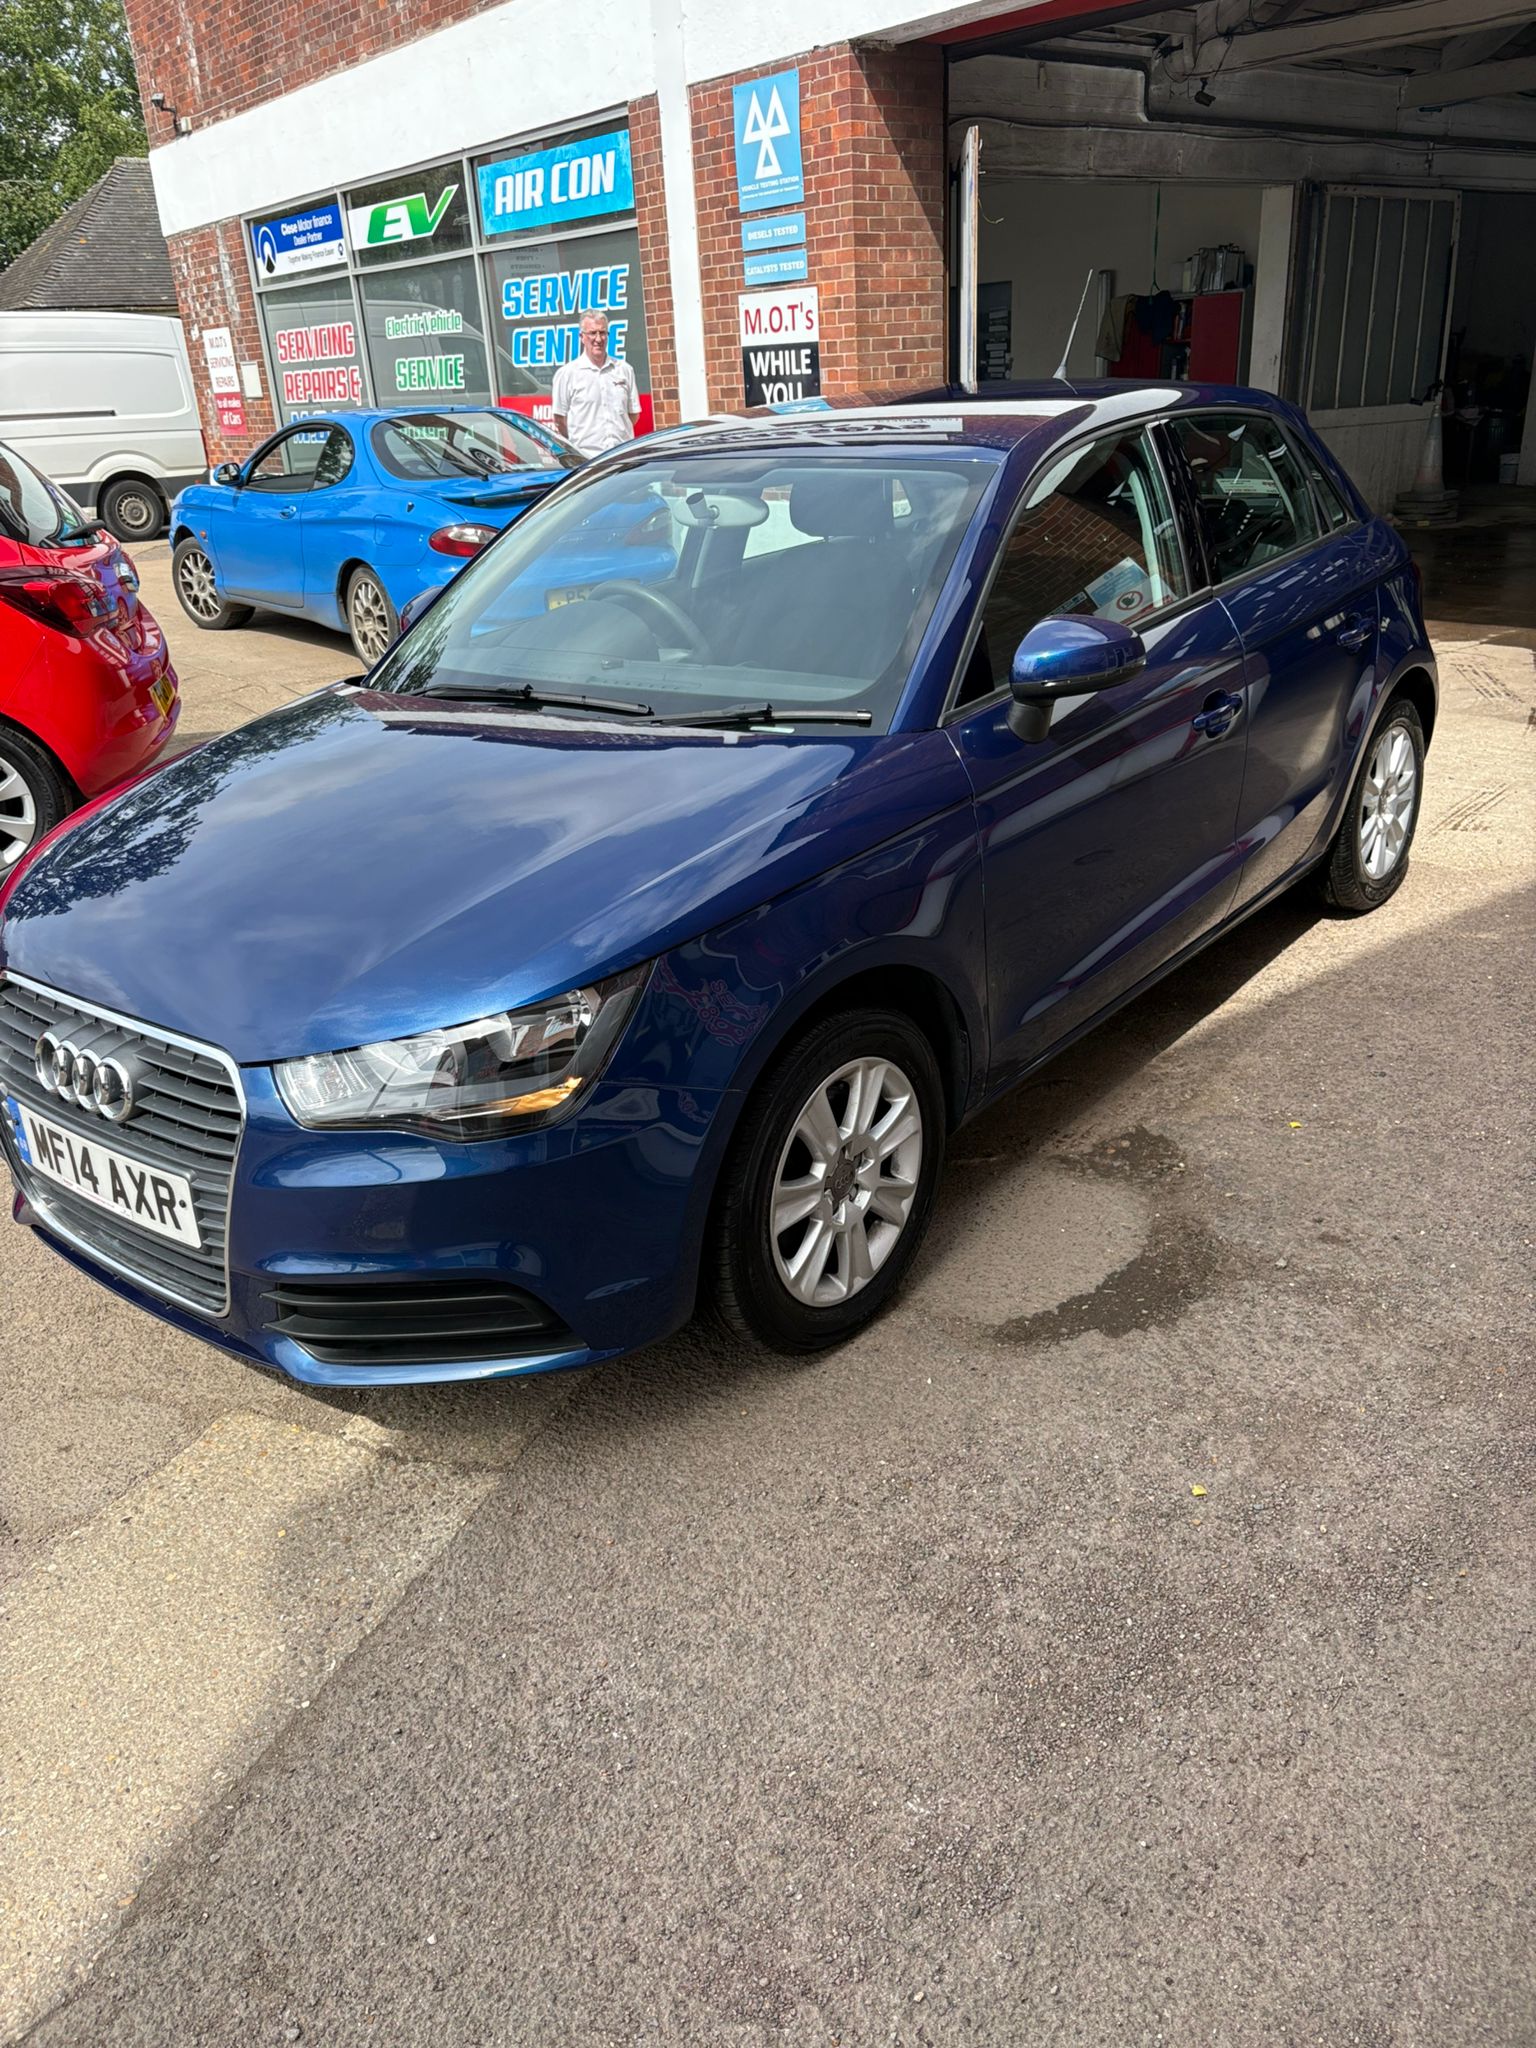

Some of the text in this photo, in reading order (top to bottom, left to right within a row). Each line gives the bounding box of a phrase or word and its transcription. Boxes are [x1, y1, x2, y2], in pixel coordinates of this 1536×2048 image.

[494, 150, 615, 217] AIR CON
[742, 176, 799, 192] VEHICLE TESTING STATION
[281, 223, 297, 236] Close
[297, 218, 313, 232] Motor
[366, 184, 459, 246] EV
[748, 225, 798, 240] DIESELS TESTED
[747, 260, 804, 275] CATALYSTS TESTED
[503, 265, 629, 320] SERVICE
[385, 309, 462, 340] Electric Vehicle
[744, 301, 814, 335] M.O.T's
[276, 321, 355, 363] SERVICING
[512, 320, 629, 368] CENTE
[395, 354, 465, 391] SERVICE
[749, 348, 812, 377] WHILE
[284, 366, 362, 406] REPAIRS &
[761, 382, 802, 405] YOU
[29, 1117, 99, 1195] MF14
[108, 1157, 182, 1230] AXR
